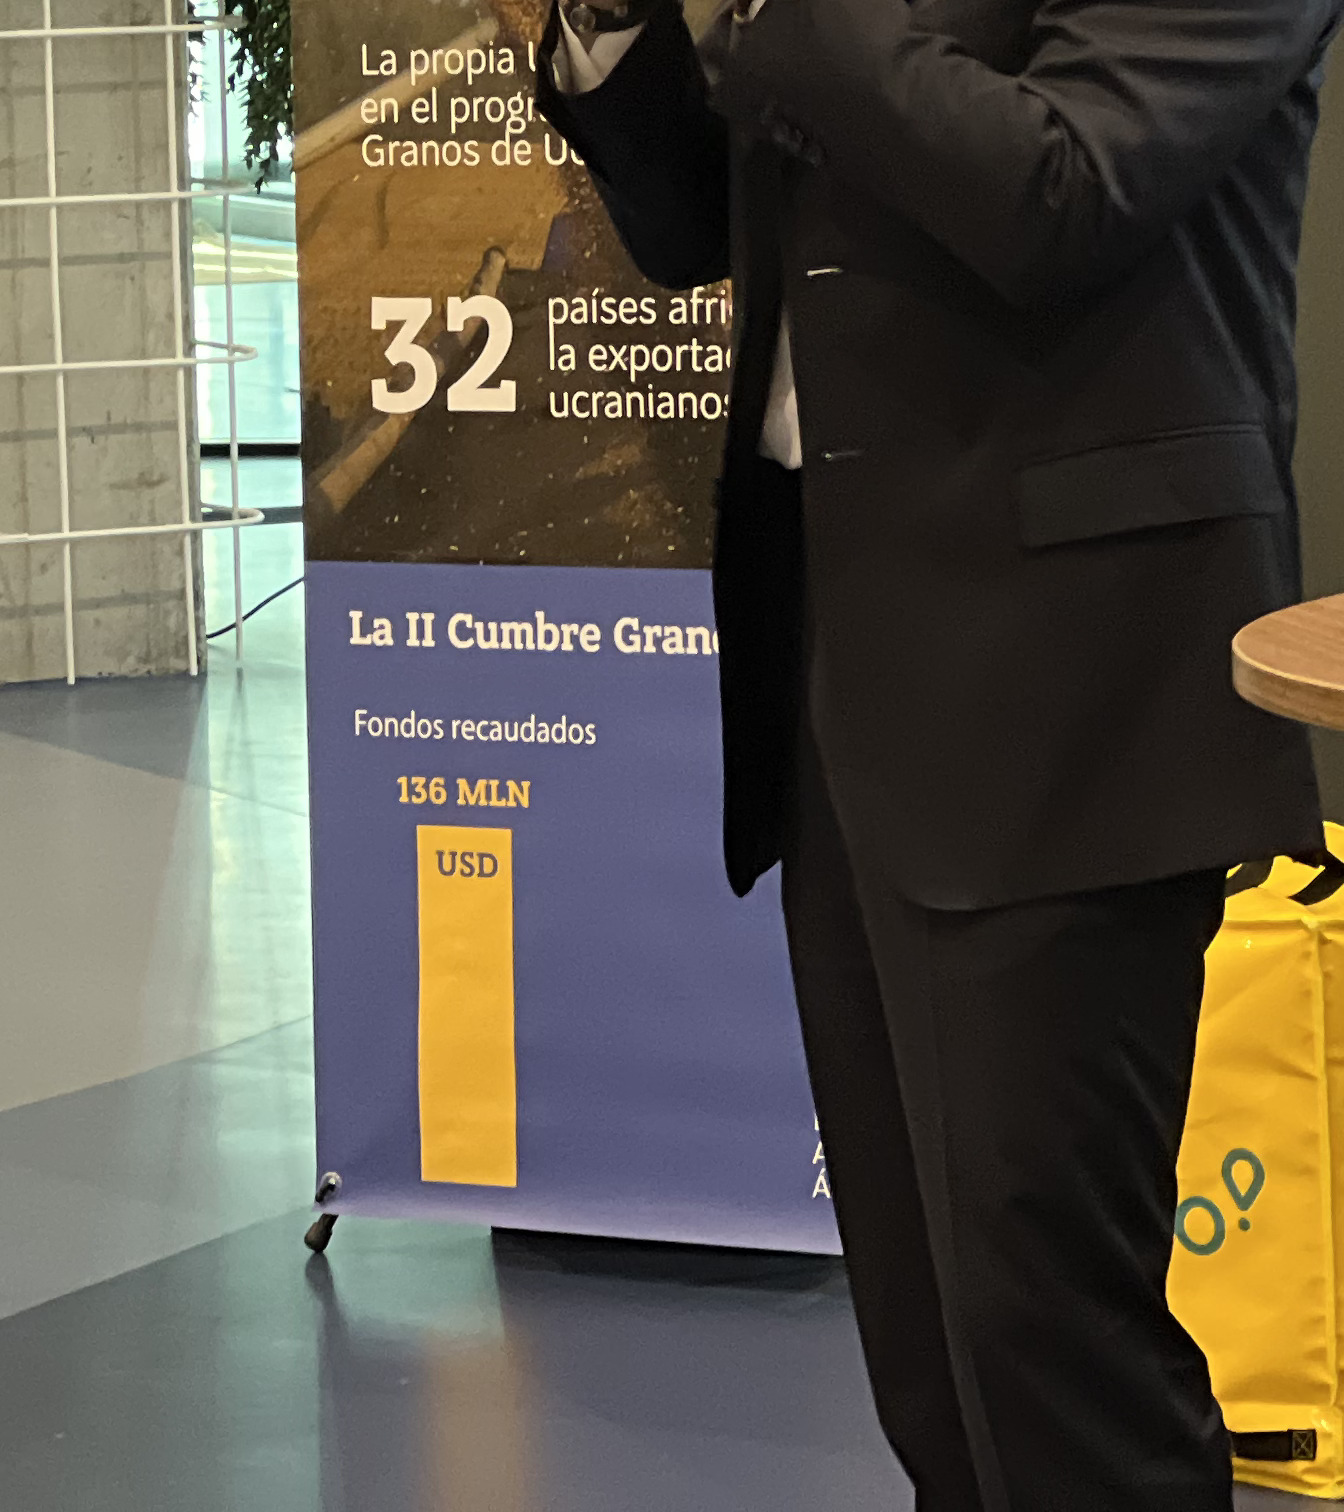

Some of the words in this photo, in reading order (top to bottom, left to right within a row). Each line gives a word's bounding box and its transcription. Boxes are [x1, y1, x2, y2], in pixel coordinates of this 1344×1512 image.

[361, 43, 398, 76] La
[410, 40, 515, 86] propia
[360, 96, 399, 124] en
[410, 86, 438, 124] el
[450, 91, 547, 135] progr
[361, 134, 480, 168] Granos
[490, 129, 532, 167] de
[548, 287, 657, 335] países
[668, 286, 733, 325] afri
[369, 295, 517, 414] 32
[549, 335, 576, 372] la
[349, 611, 394, 647] La
[405, 611, 436, 648] II
[447, 610, 602, 653] Cumbre
[613, 616, 720, 656] Gran
[354, 709, 445, 740] Fondos
[451, 713, 597, 745] recaudados
[396, 775, 448, 805] 136
[456, 777, 531, 809] MLN
[435, 849, 499, 879] USD
